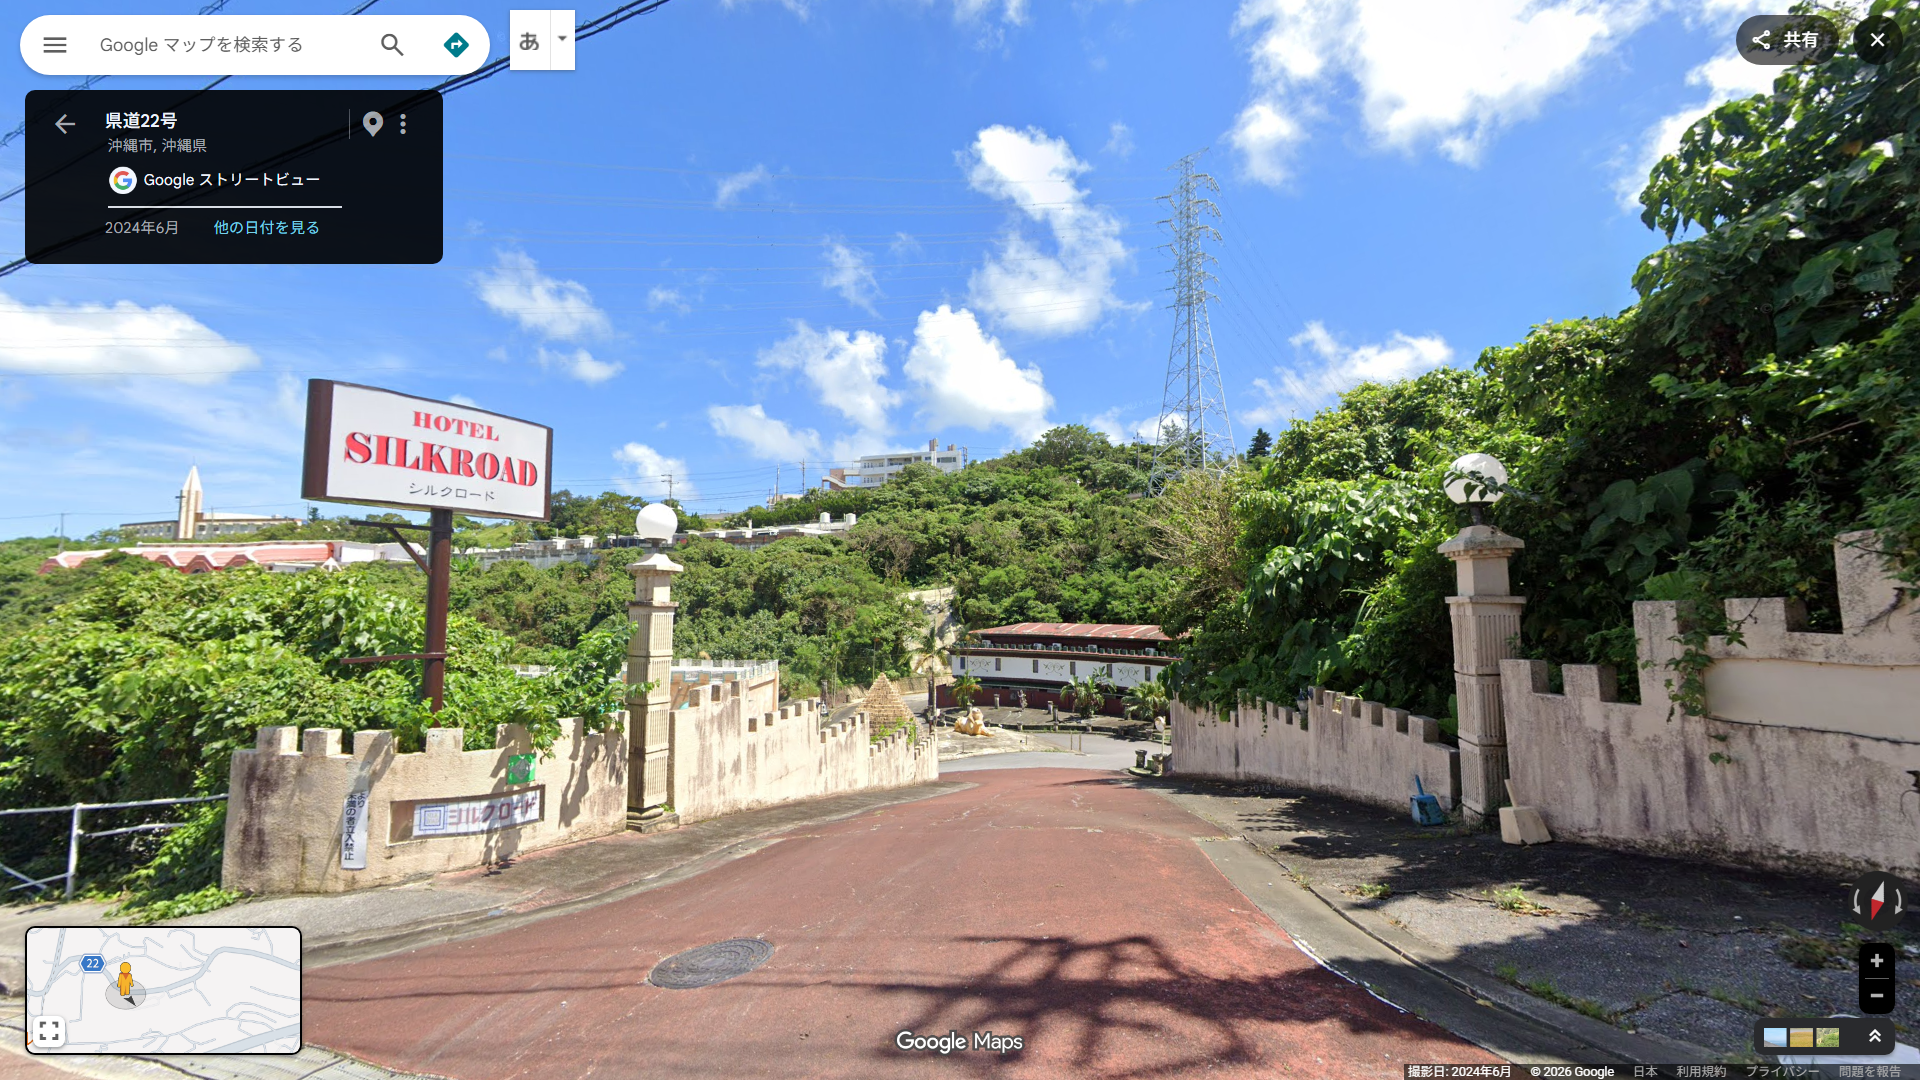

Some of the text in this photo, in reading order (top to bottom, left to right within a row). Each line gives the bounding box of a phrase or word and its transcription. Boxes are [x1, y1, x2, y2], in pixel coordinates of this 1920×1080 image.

[413, 410, 500, 442] HOTEL
[343, 430, 538, 487] SILKROAD
[409, 482, 495, 502] シルクロード
[448, 796, 538, 826] シルクロード
